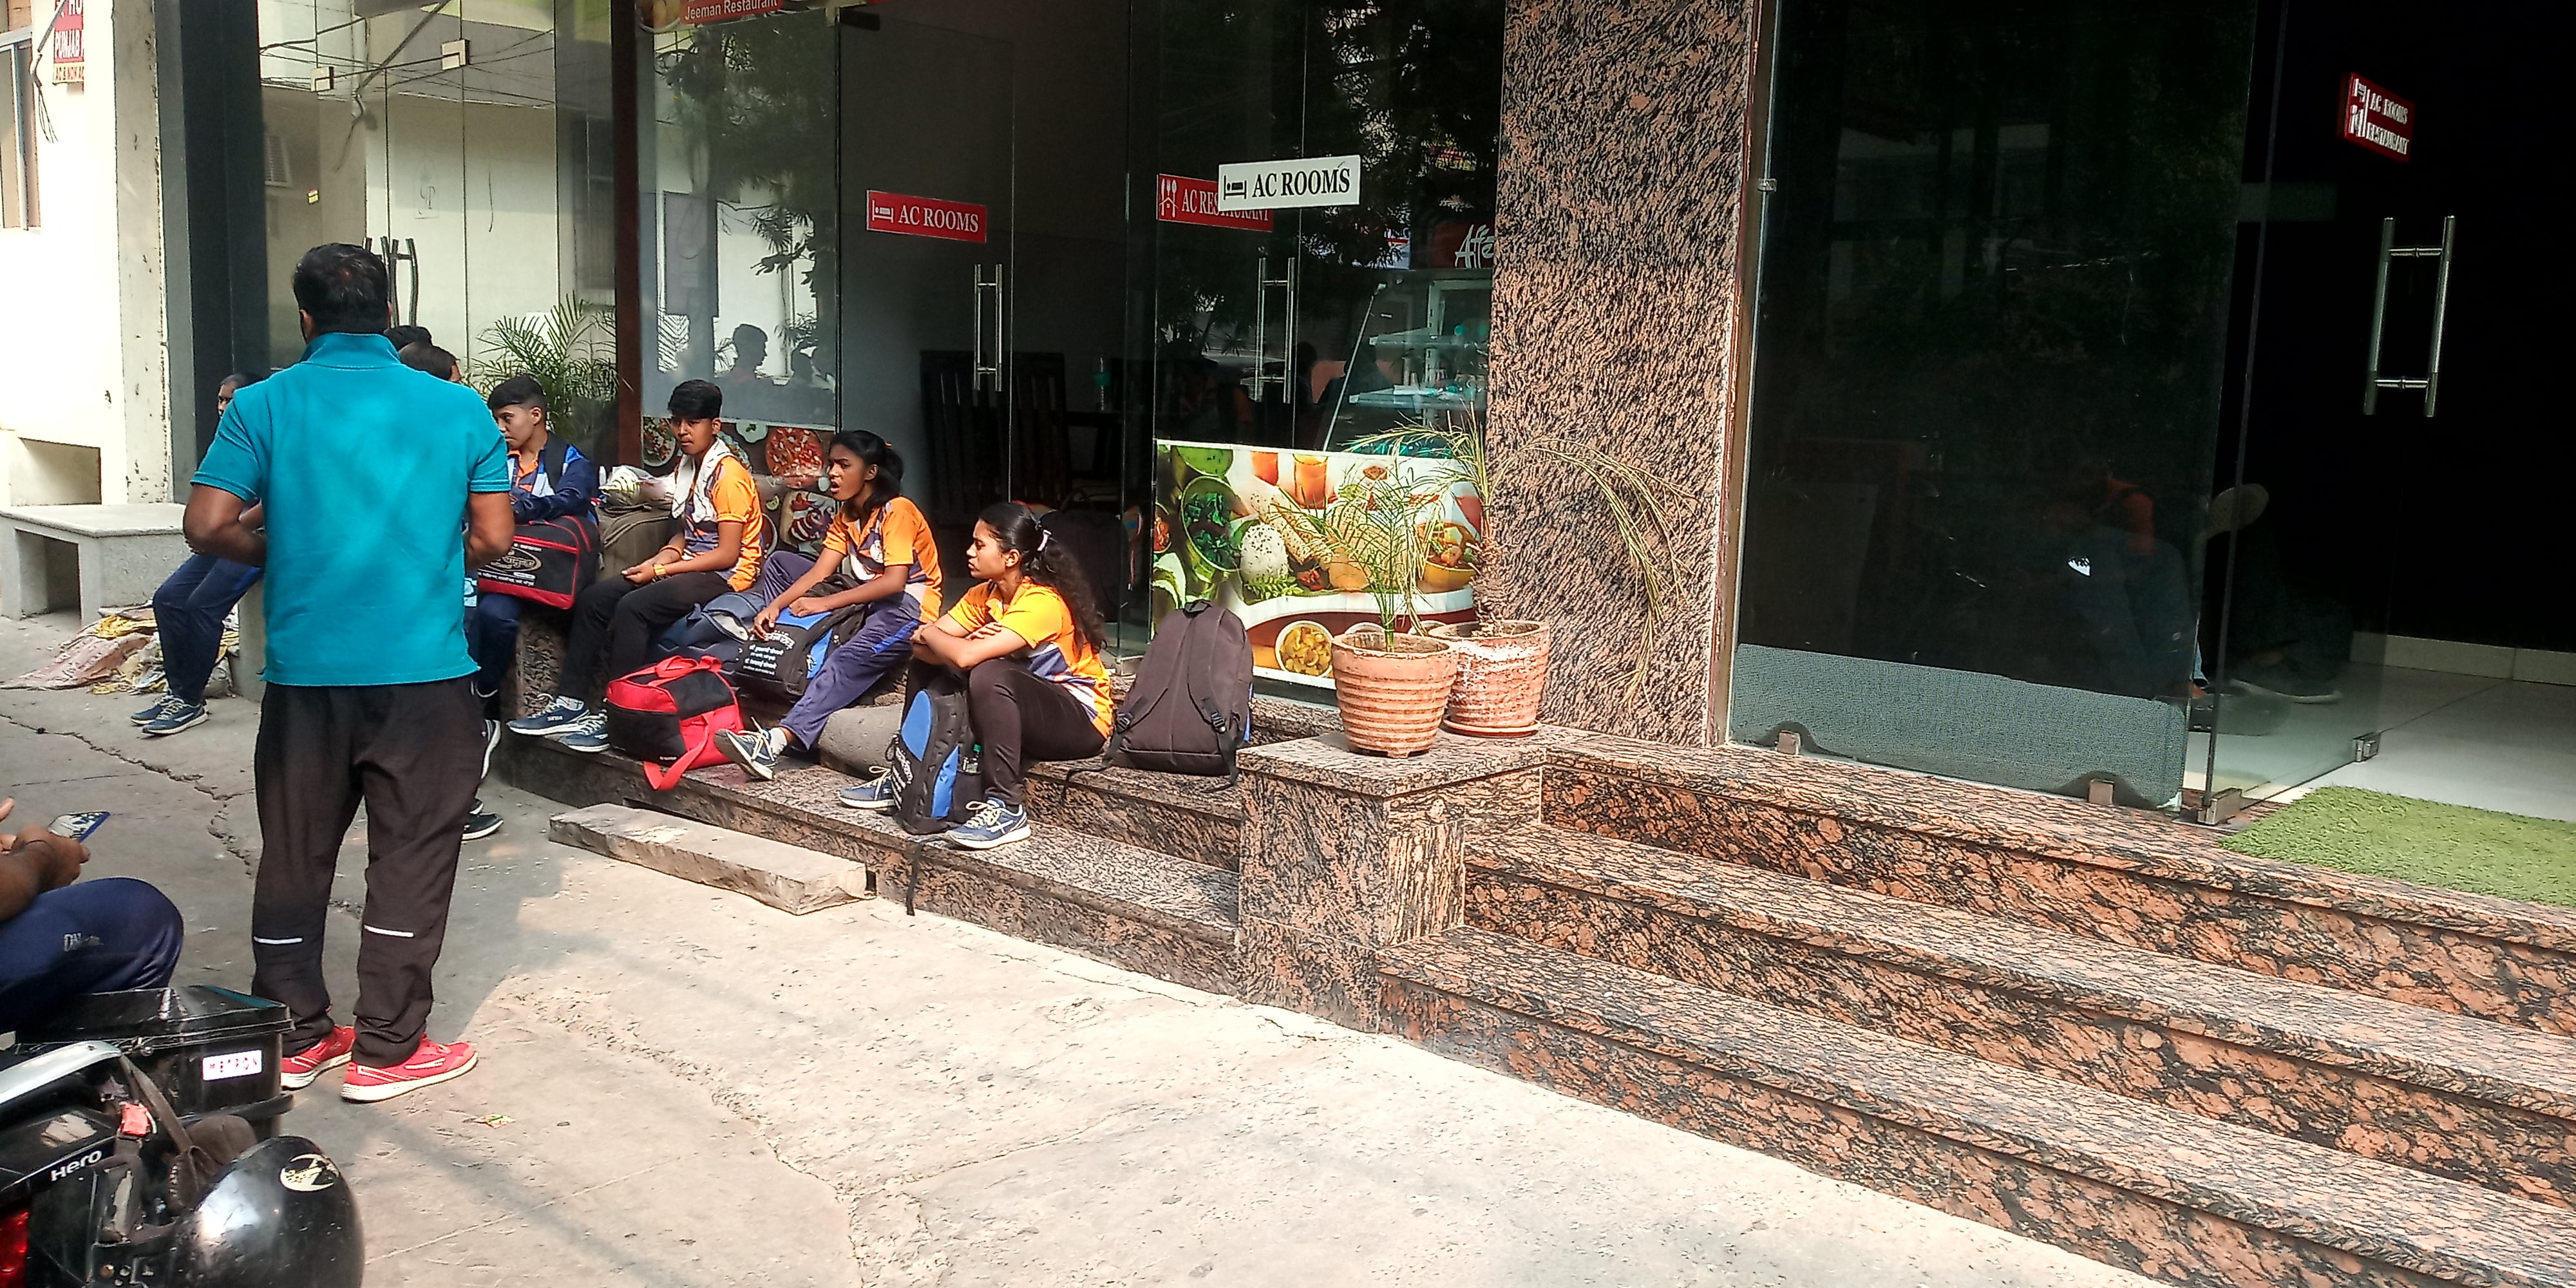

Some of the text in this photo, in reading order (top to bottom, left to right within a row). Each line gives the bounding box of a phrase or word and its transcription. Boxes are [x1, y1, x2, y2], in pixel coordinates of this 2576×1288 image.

[685, 0, 778, 20] Jeeman Restaurant
[55, 30, 80, 61] PUNJAB
[2370, 93, 2409, 124] AC ROOMS
[2366, 122, 2409, 155] RESTAURANT
[1252, 167, 1350, 198] AC ROOMS
[1181, 189, 1198, 213] AC
[898, 205, 979, 233] AC ROOMS
[51, 1150, 102, 1182] Hero
